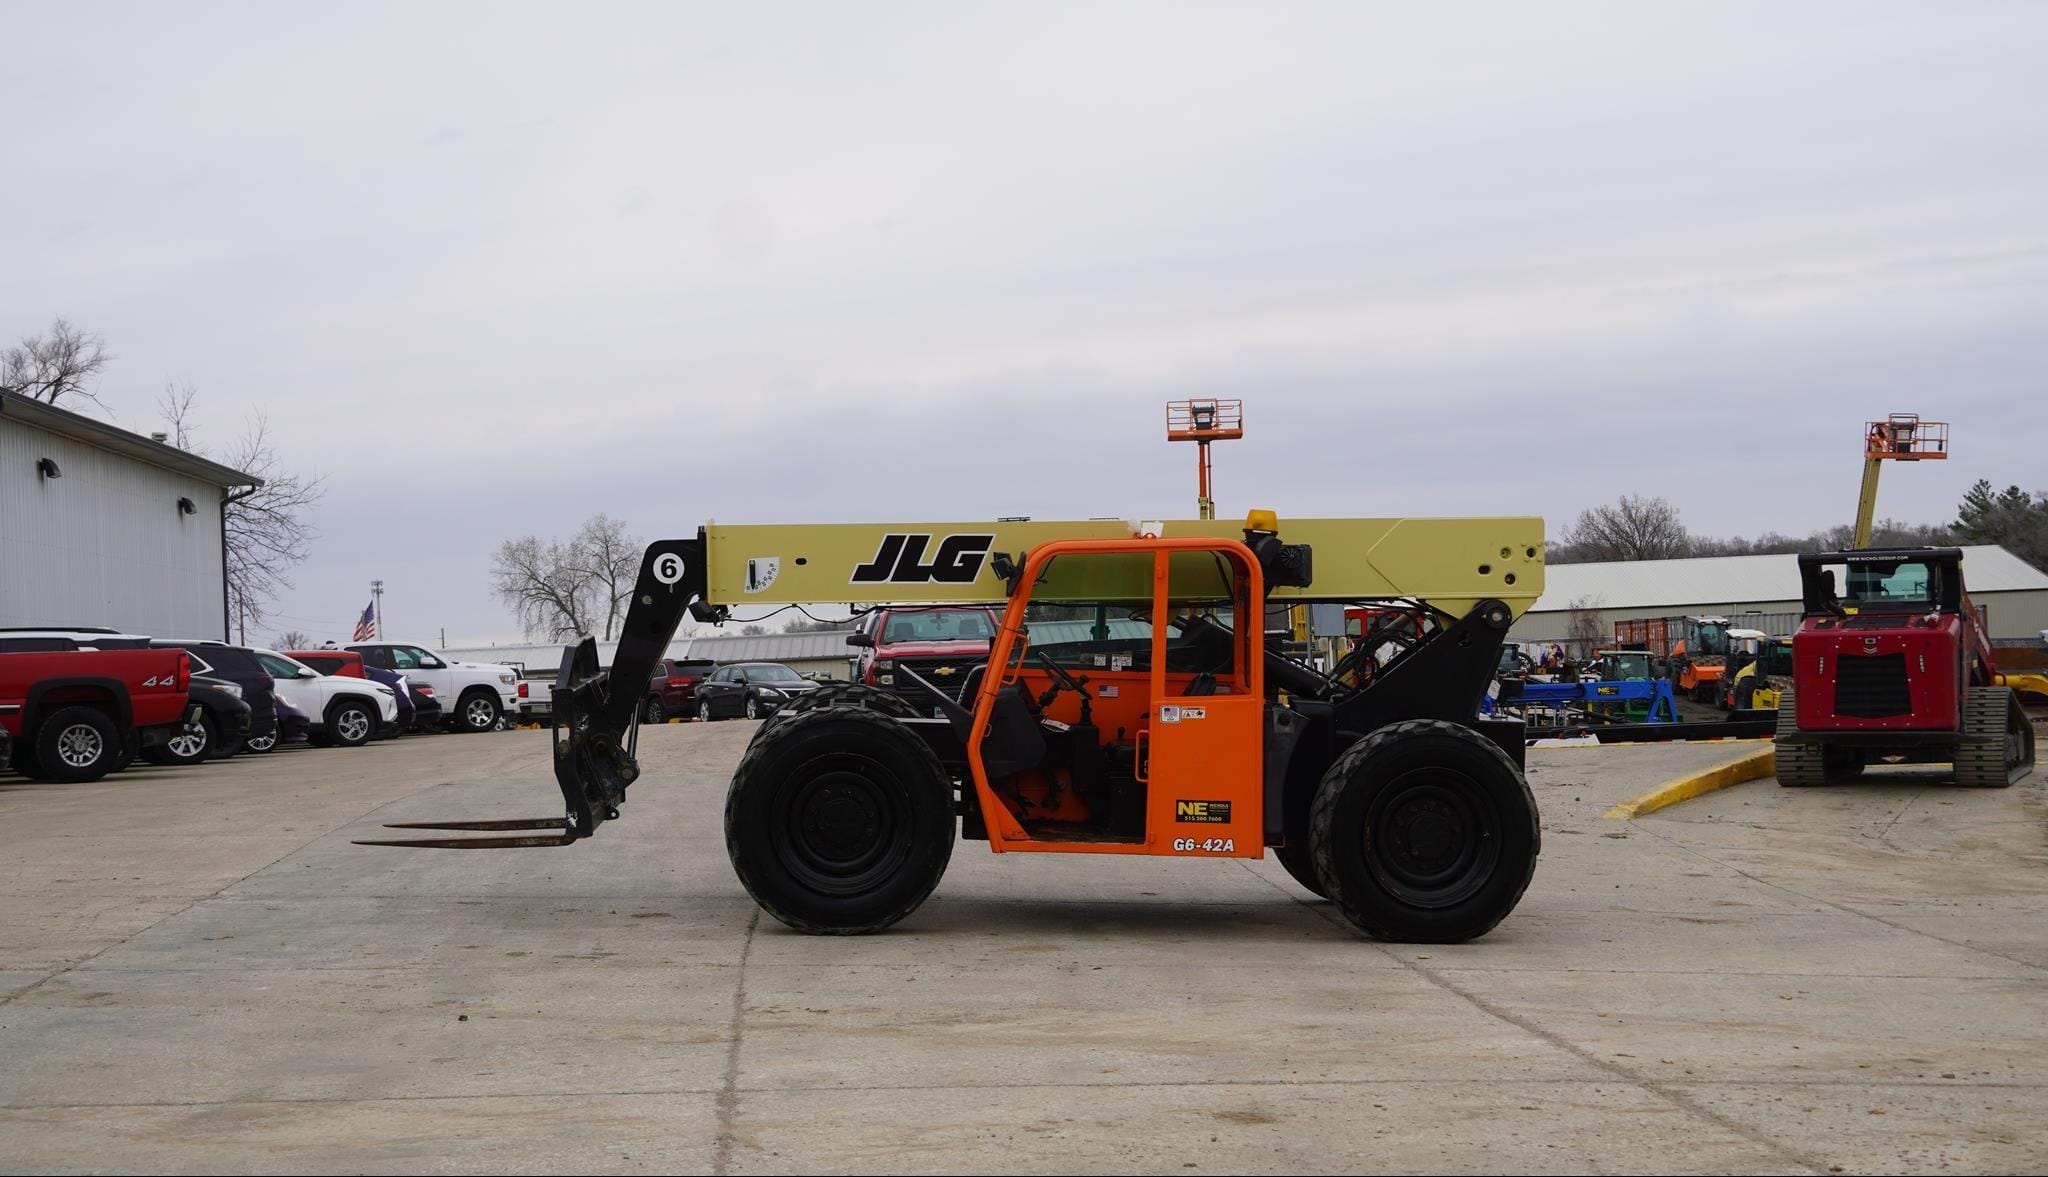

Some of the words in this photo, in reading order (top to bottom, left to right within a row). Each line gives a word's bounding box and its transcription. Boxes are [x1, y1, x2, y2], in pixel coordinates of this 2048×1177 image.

[849, 534, 996, 584] JLG
[660, 558, 677, 579] 6
[1177, 801, 1208, 816] NE
[1173, 838, 1235, 852] G6-42A
